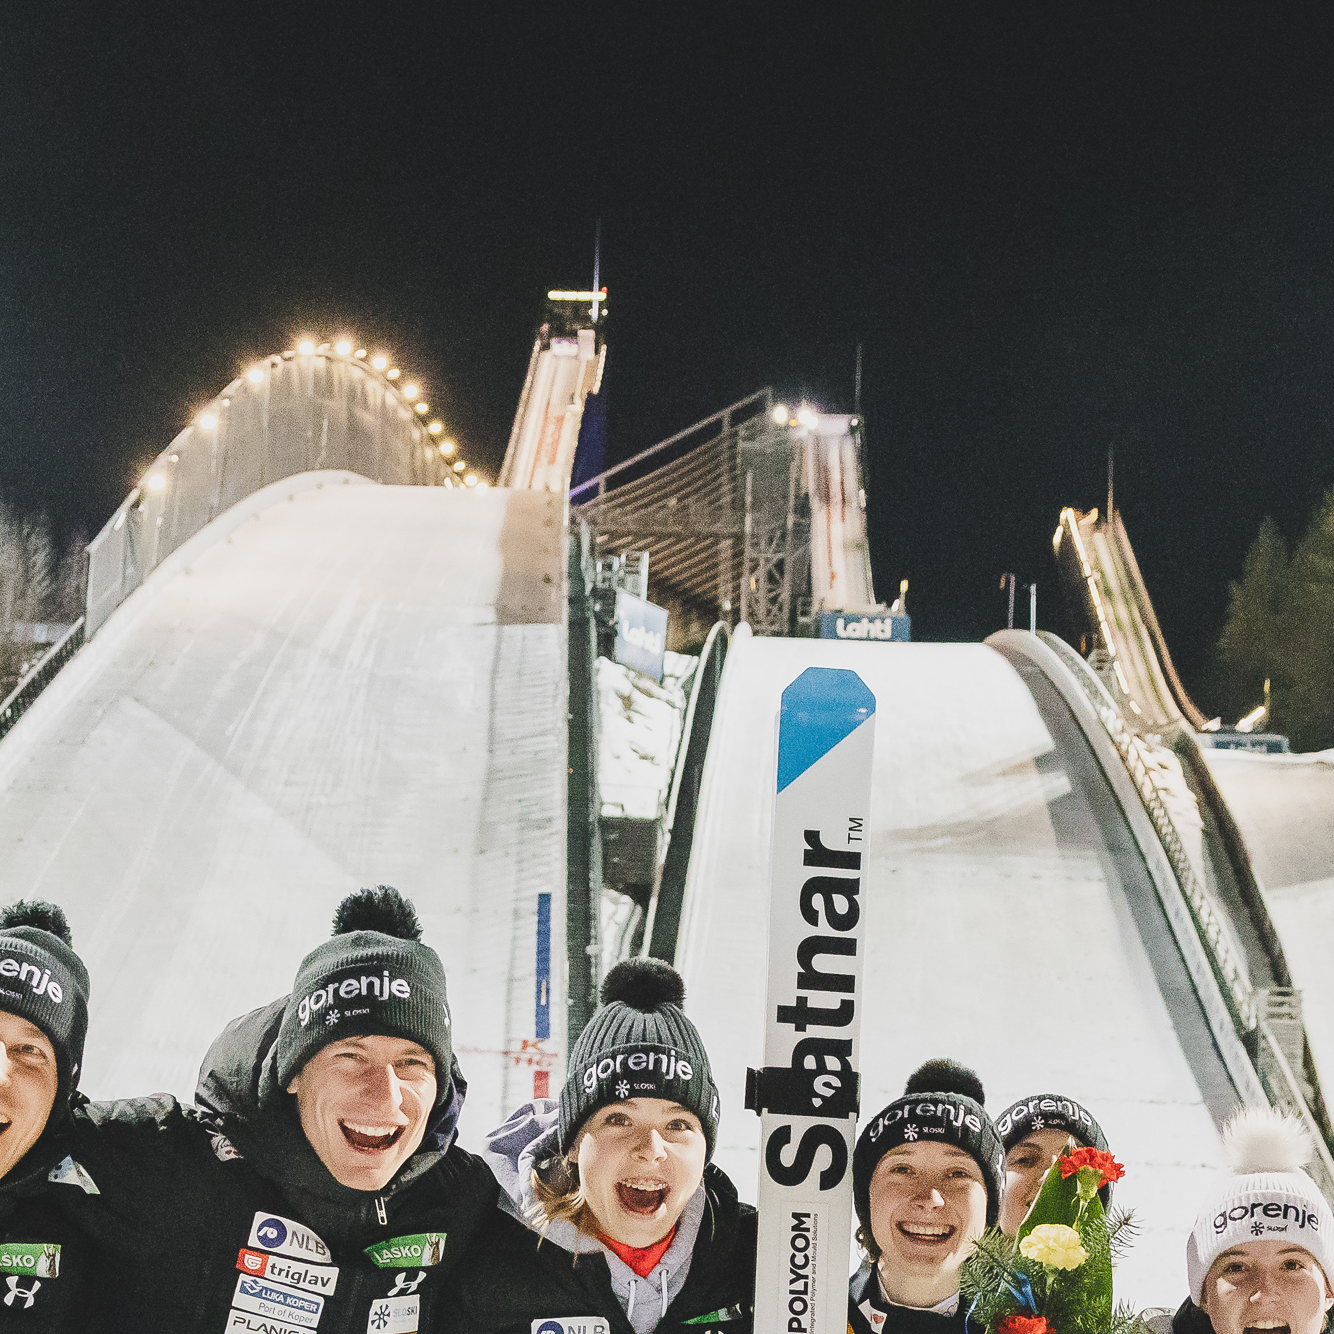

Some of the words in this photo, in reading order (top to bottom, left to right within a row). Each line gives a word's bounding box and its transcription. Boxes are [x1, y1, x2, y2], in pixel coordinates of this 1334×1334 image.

[836, 618, 892, 640] Lahti
[298, 971, 411, 1027] gorenje
[767, 829, 862, 1192] Satnar
[583, 1050, 694, 1093] gorenje
[869, 1101, 982, 1142] gorenje
[997, 1098, 1093, 1135] gorenje
[1213, 1203, 1319, 1234] gorenje
[289, 1230, 326, 1256] NLB
[270, 1262, 331, 1287] triglav
[788, 1212, 811, 1333] POLYCOM
[258, 1302, 276, 1314] Port
[277, 1306, 286, 1316] of
[287, 1311, 313, 1324] Koper
[261, 1289, 284, 1302] LUKA
[286, 1296, 318, 1312] KOPER
[809, 1302, 817, 1334] Integrated
